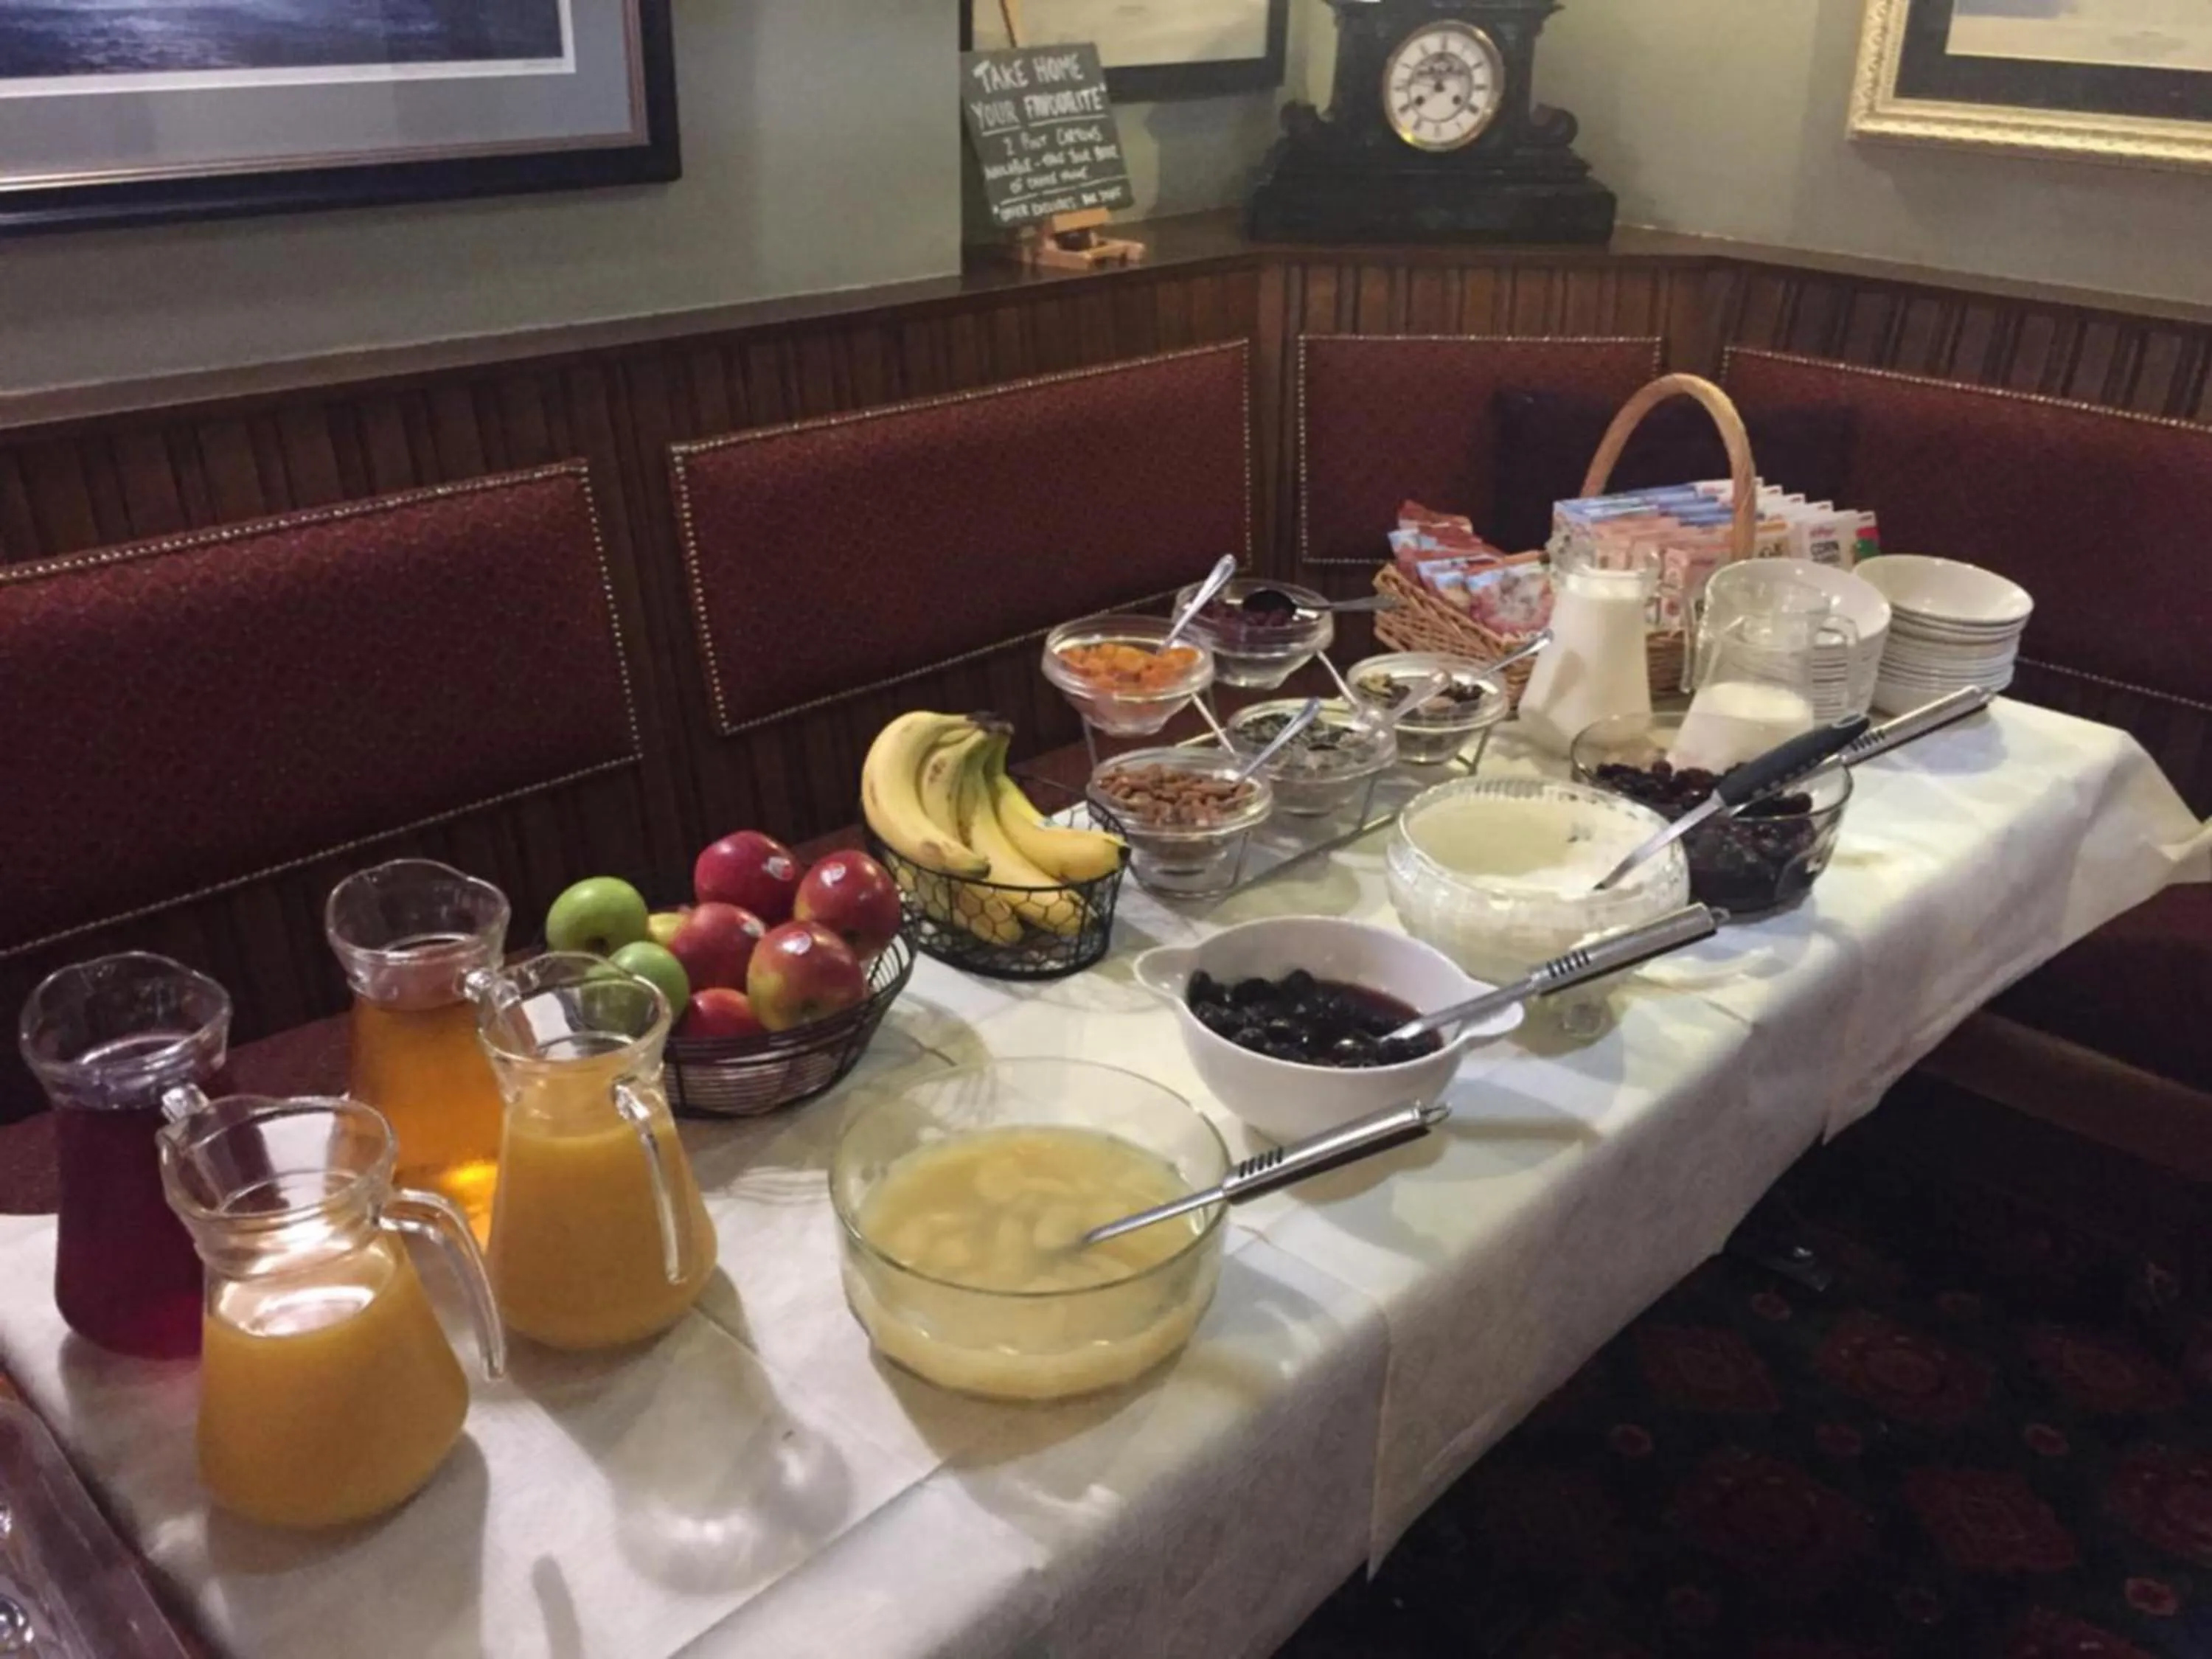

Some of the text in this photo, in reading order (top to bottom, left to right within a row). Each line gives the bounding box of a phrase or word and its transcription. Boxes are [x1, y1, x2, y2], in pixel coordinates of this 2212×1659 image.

[972, 52, 1084, 94] TAKE HOME
[970, 101, 1020, 131] YOUR
